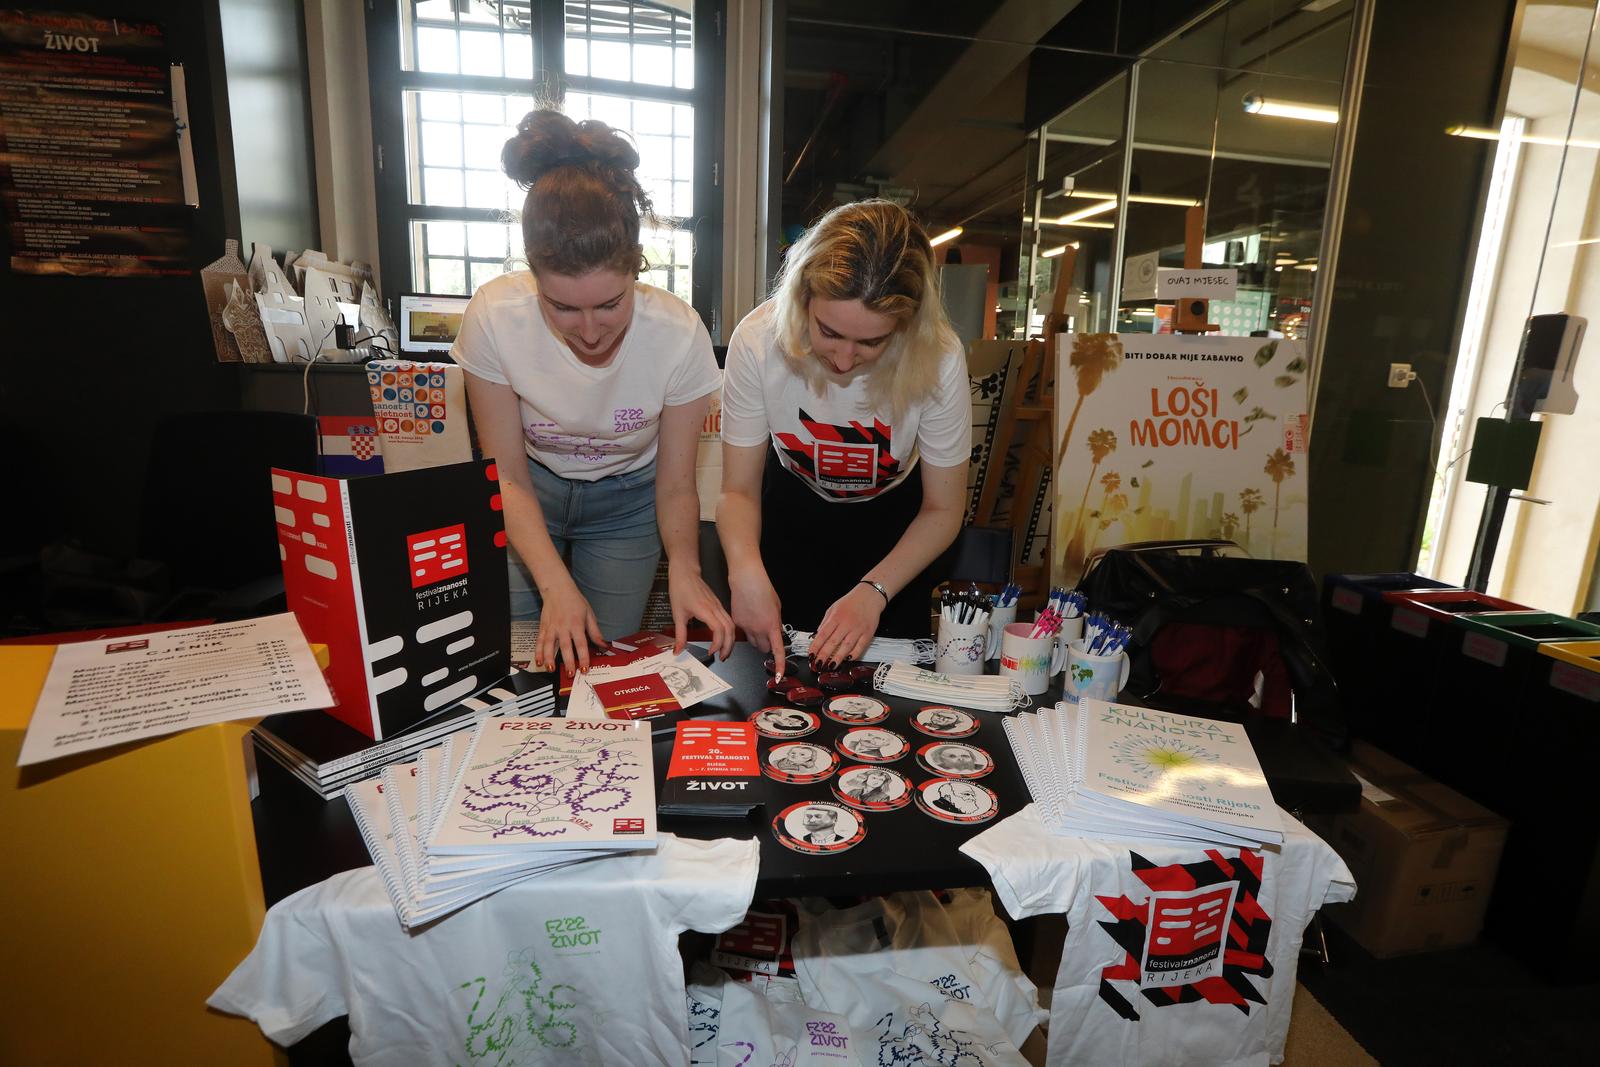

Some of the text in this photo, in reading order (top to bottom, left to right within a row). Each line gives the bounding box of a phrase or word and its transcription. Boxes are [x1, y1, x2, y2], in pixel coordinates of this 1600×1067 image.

[45, 30, 100, 53] ŽIVOT
[1168, 276, 1229, 285] OVAJ MJESEC
[1180, 354, 1198, 362] NIJE
[1201, 354, 1243, 362] ZABAVNO
[1151, 381, 1218, 418] LOŠI
[614, 420, 648, 433] ŽIVOT
[1130, 418, 1238, 450] MOMCI
[416, 577, 468, 600] festivalznanosti
[418, 587, 468, 610] RIJEKA
[146, 642, 223, 656] CJENIK
[614, 684, 651, 696] OTKRIĆA
[566, 720, 632, 732] ŽIVOT
[1109, 706, 1223, 732] KULTURA
[1100, 713, 1237, 744] ZNANOSTI
[686, 780, 749, 791] ŽIVOT
[1216, 798, 1261, 811] Rijeka
[549, 930, 602, 948] ŽIVOT
[1149, 947, 1218, 968] festivalznanosti
[1147, 962, 1213, 982] RIJEKA
[809, 1031, 849, 1049] ŽIVOT
